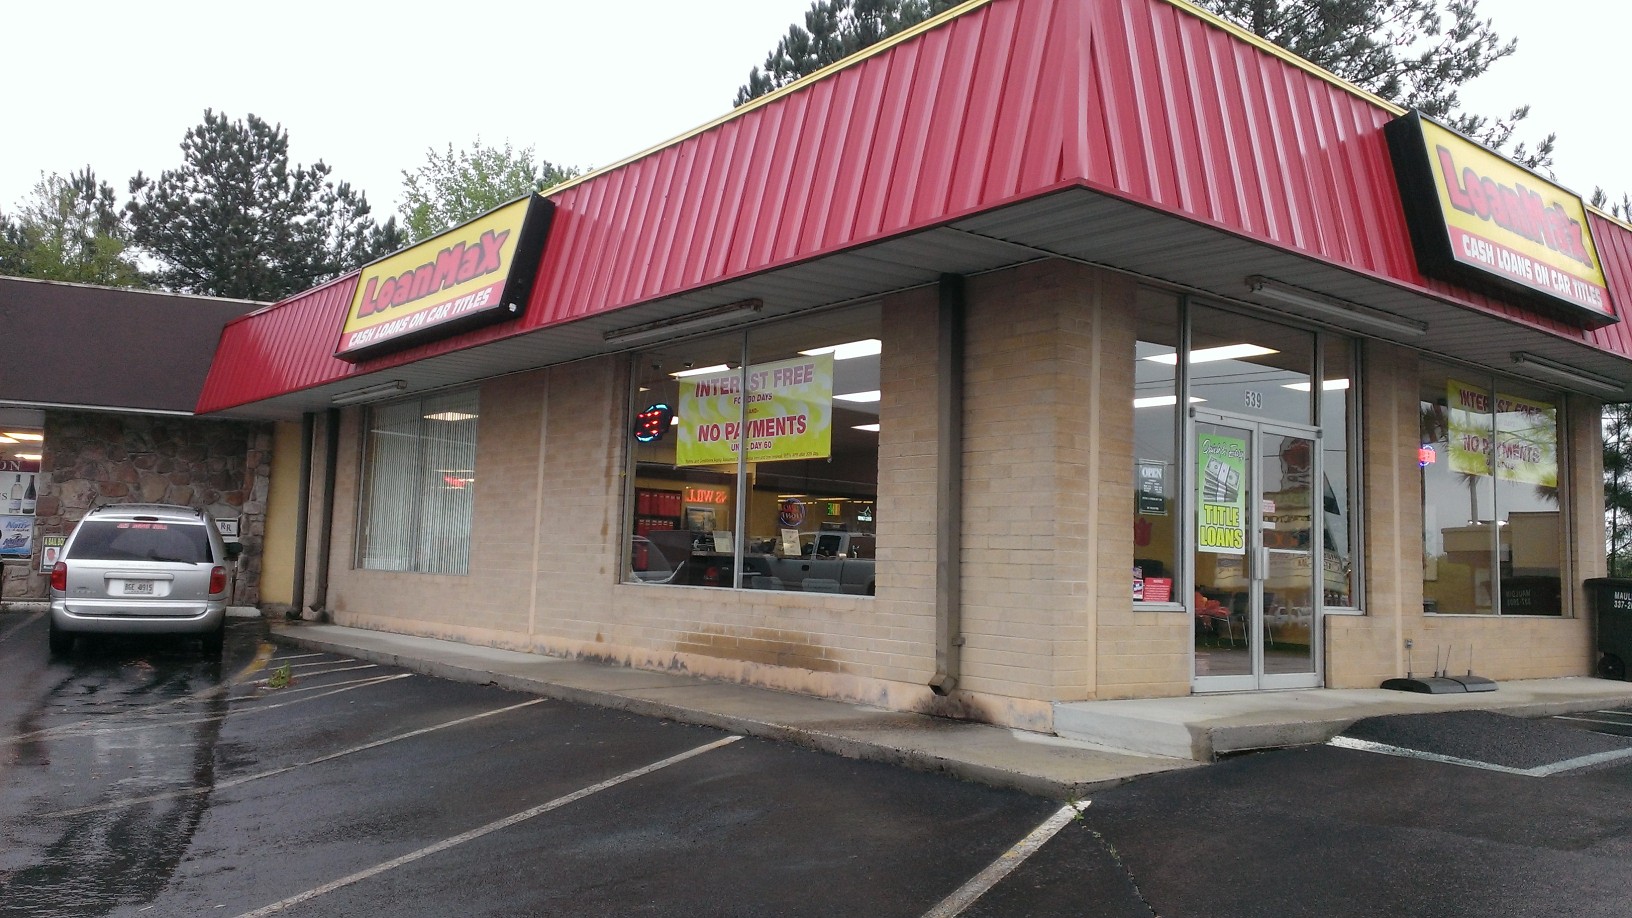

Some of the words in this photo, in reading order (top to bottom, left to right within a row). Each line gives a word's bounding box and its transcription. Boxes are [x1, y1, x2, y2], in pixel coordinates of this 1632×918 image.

[1462, 234, 1495, 265] CASH
[1497, 248, 1532, 280] LOANS
[1534, 263, 1550, 287] ON
[1551, 270, 1572, 295] CAR
[1572, 279, 1603, 308] TITLES
[348, 328, 375, 347] CASH
[374, 316, 410, 339] LOANS
[409, 310, 428, 328] ON
[426, 302, 452, 323] CAR
[451, 288, 493, 315] TITLES
[695, 371, 769, 397] INTERST
[773, 364, 815, 388] FREE
[757, 394, 773, 403] DAYS
[1245, 391, 1261, 408] 539
[698, 424, 721, 442] NO
[751, 442, 762, 450] DAY
[764, 441, 772, 449] 60
[1463, 434, 1480, 453] NO
[1203, 504, 1240, 527] TITLE
[1200, 525, 1243, 549] LOANS
[1614, 591, 1632, 600] MAUL
